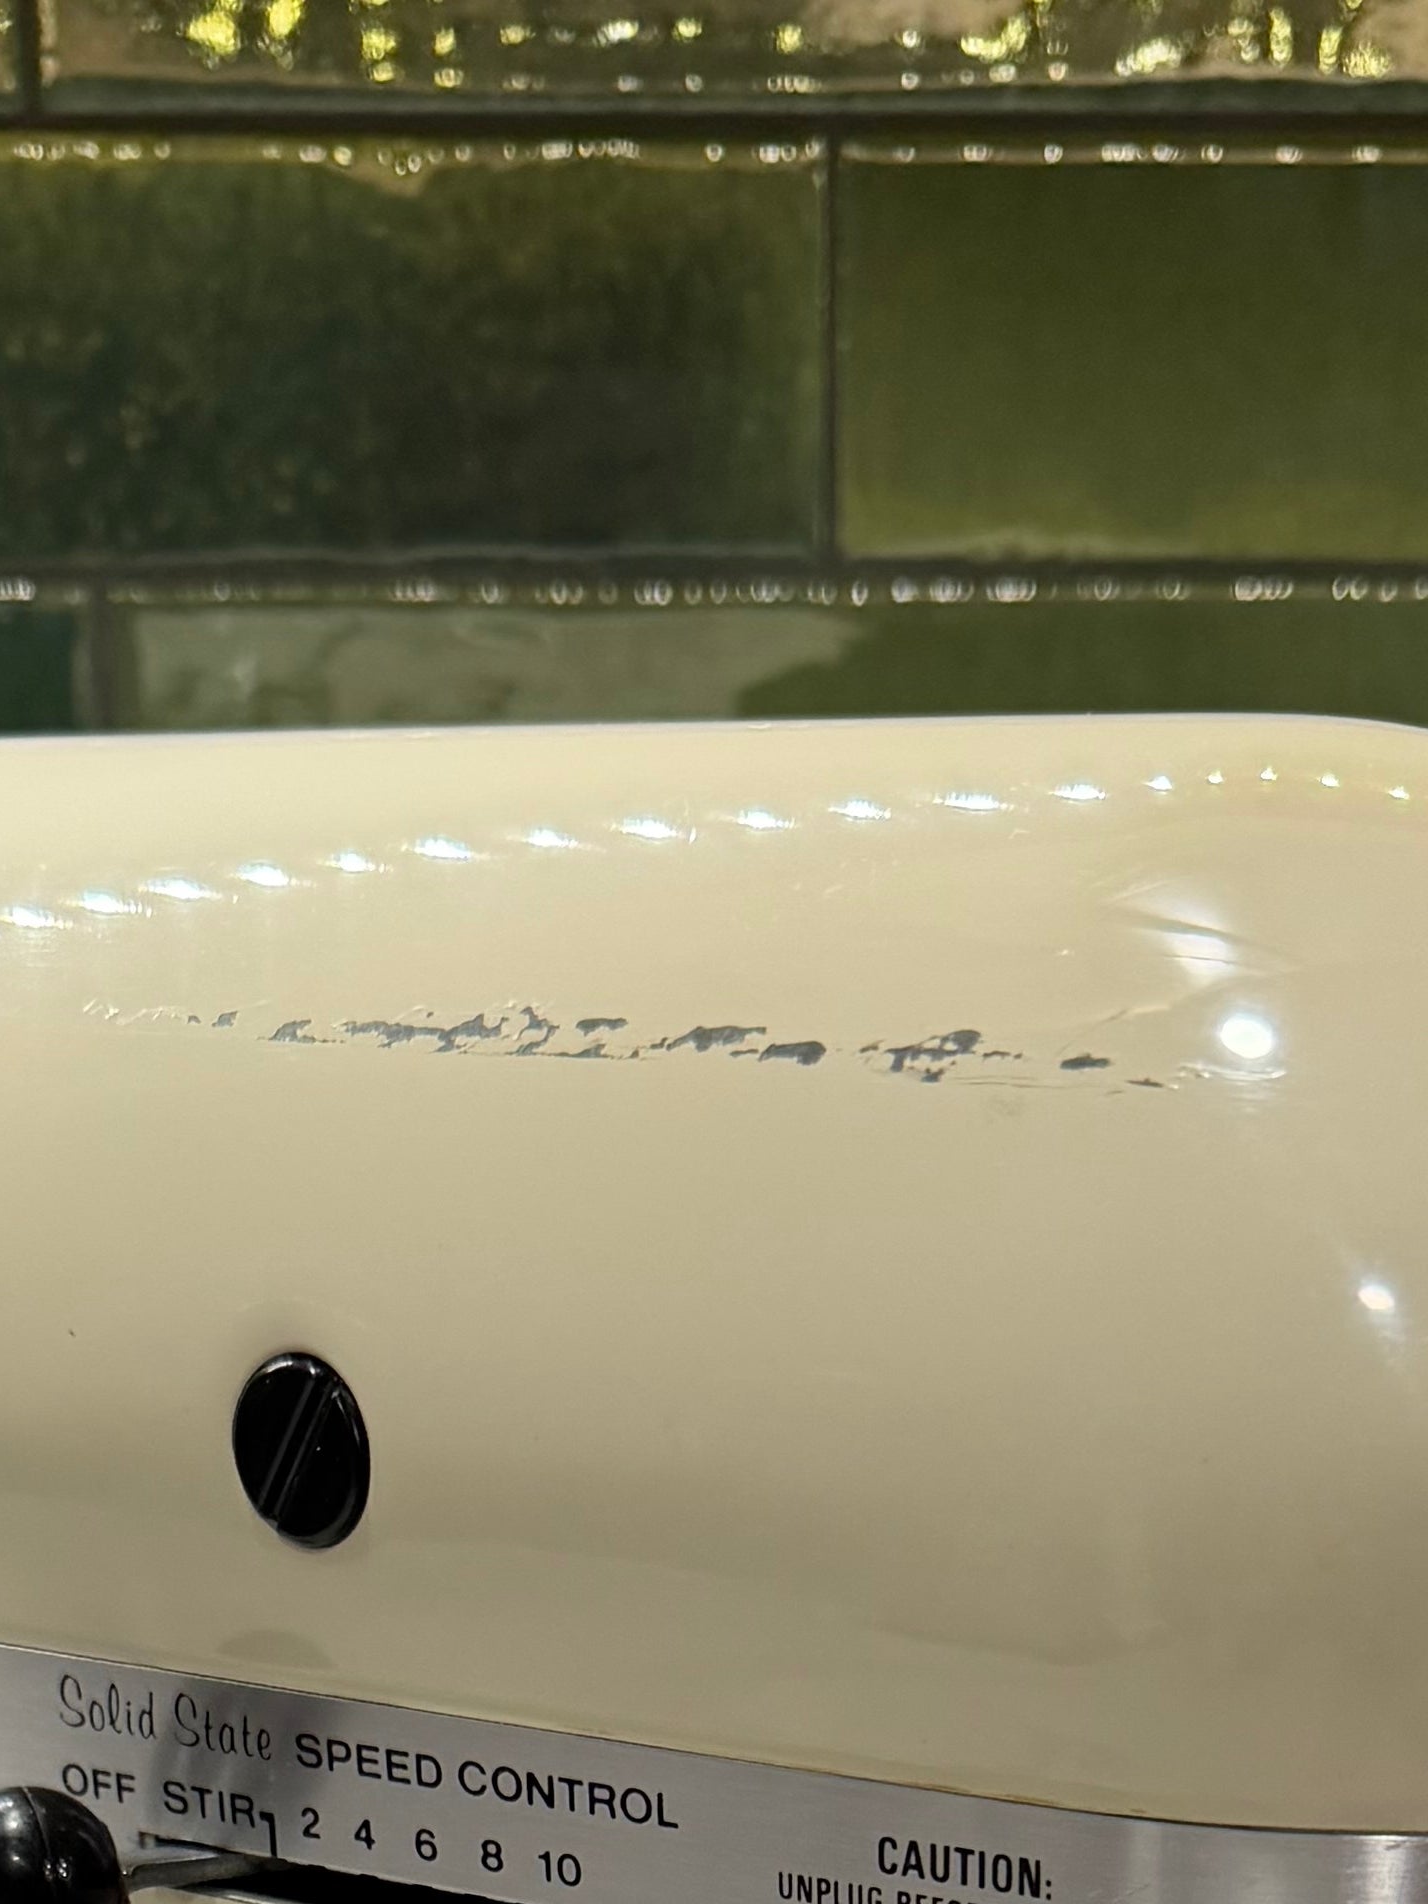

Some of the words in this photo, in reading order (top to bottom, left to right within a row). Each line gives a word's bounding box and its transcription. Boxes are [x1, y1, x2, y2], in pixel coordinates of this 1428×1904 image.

[59, 1674, 157, 1740] Solid
[173, 1692, 273, 1762] State
[295, 1734, 443, 1789] SPEED
[458, 1759, 679, 1829] CONTROL
[61, 1763, 136, 1805] OFF
[162, 1780, 256, 1828] STIR
[301, 1806, 320, 1839] 2
[354, 1818, 375, 1850] 4
[415, 1828, 438, 1861] 6
[481, 1839, 504, 1872] 8
[538, 1848, 582, 1887] 10
[877, 1835, 1053, 1900] CAUTION:
